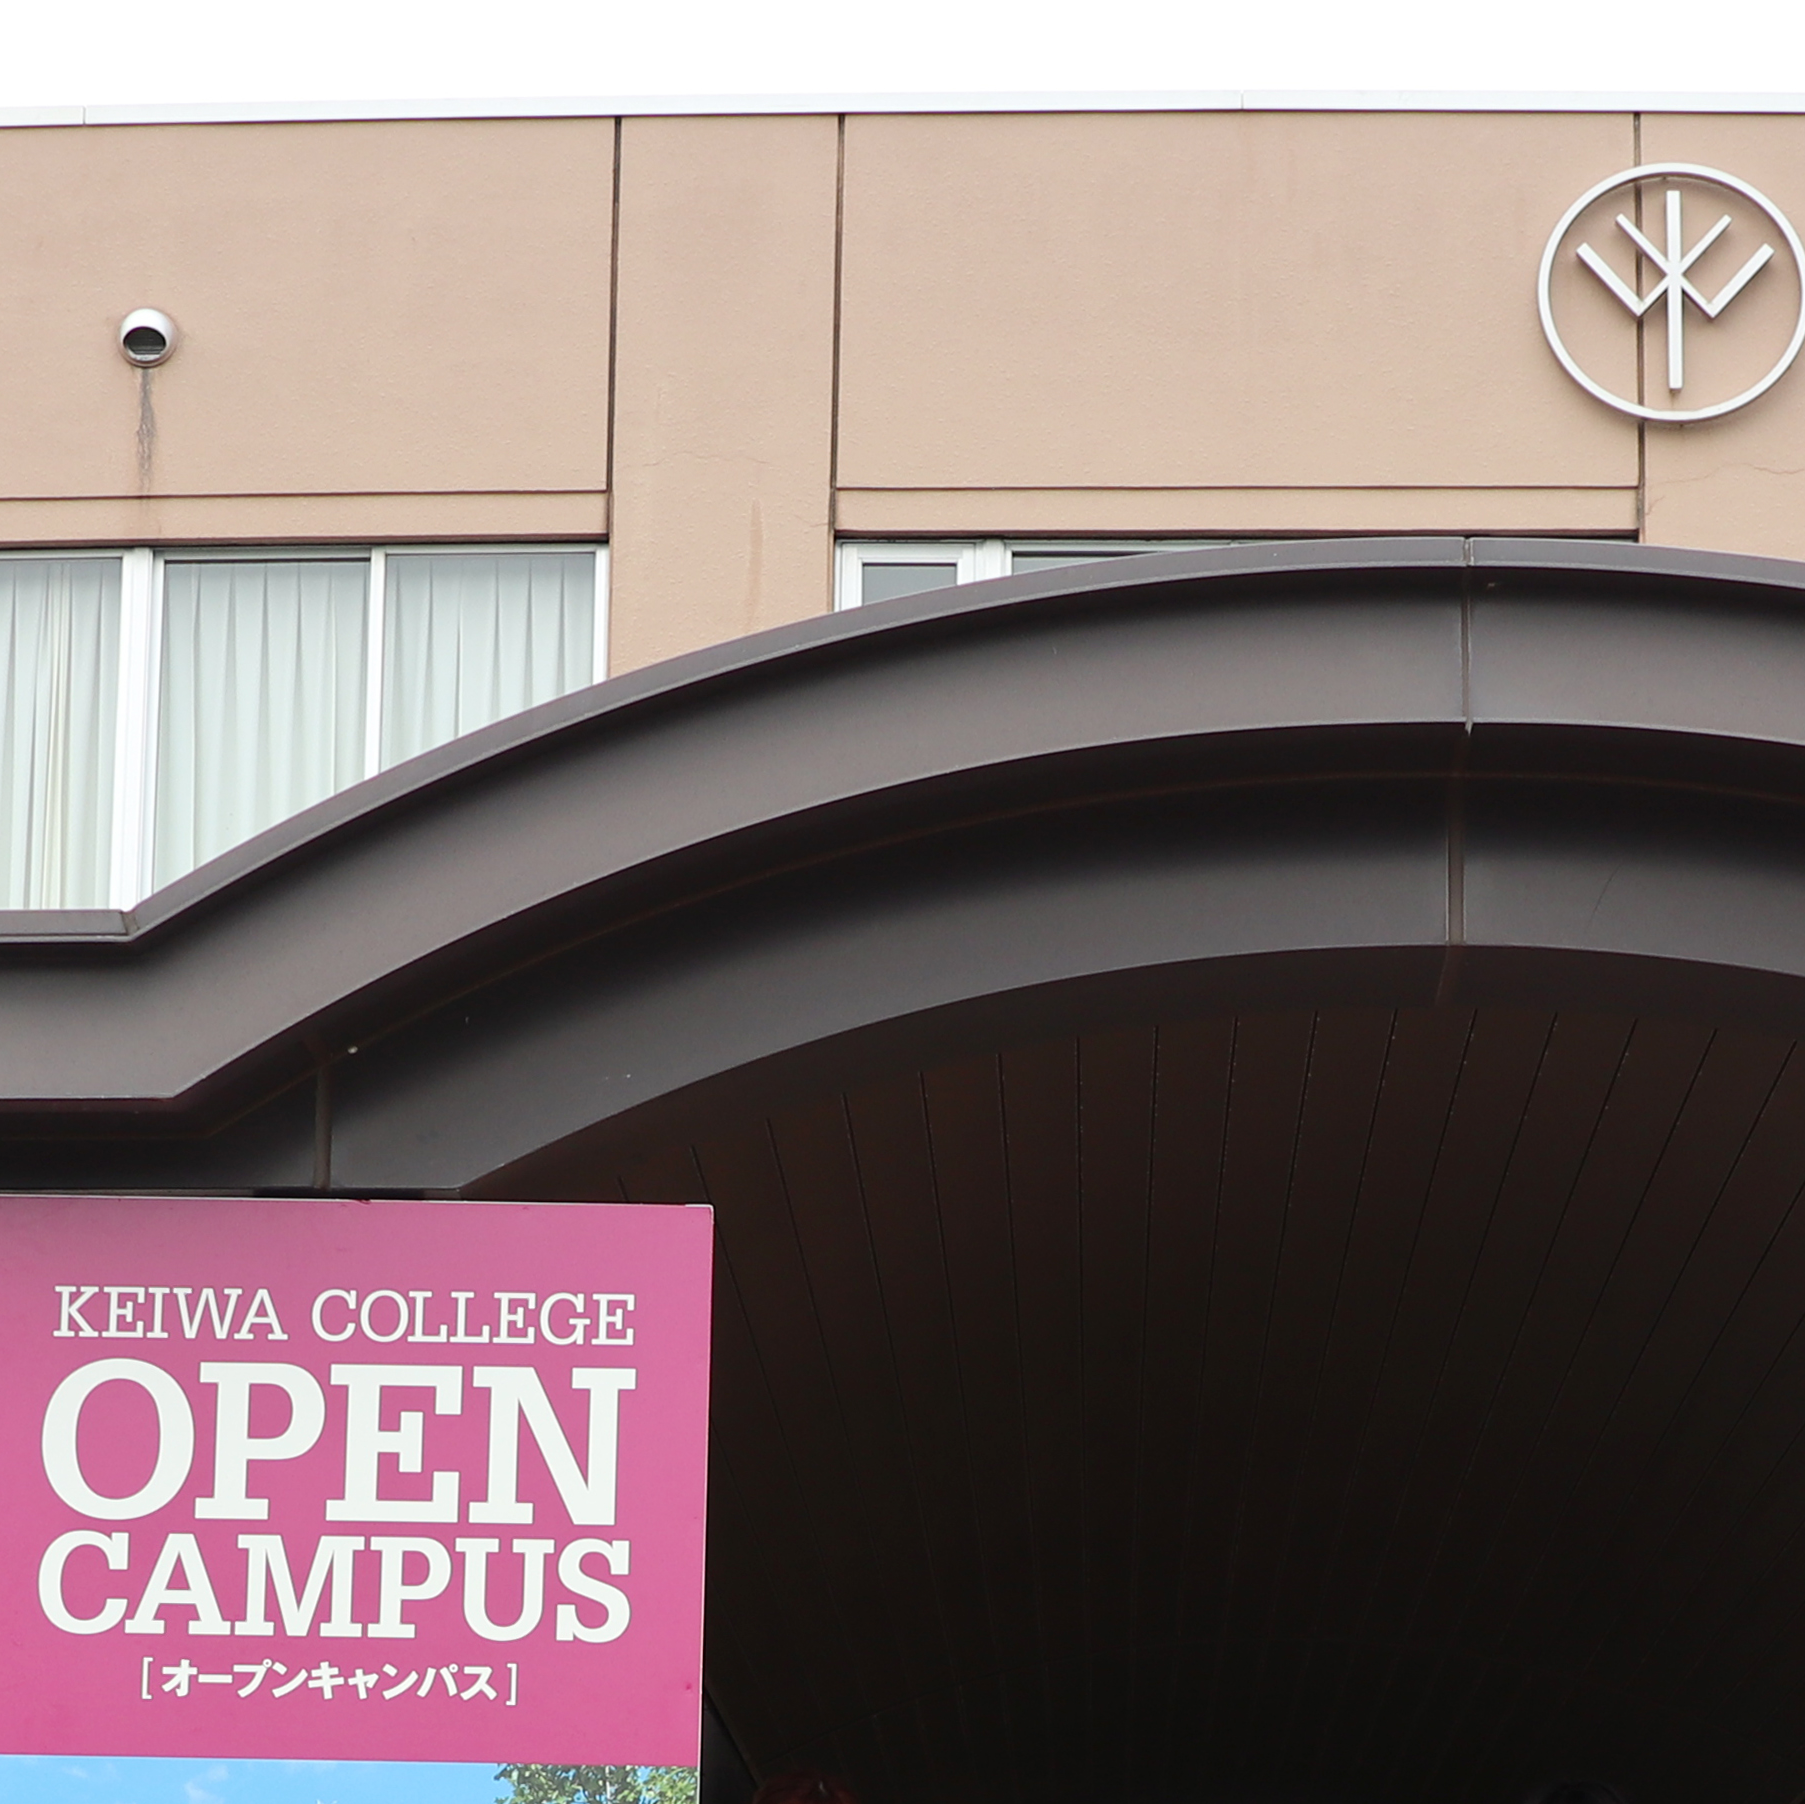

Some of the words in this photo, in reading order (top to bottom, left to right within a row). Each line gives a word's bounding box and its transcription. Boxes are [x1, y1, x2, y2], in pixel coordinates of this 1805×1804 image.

[53, 1285, 289, 1341] KEIWA
[311, 1289, 636, 1346] COLLEGE
[41, 1358, 637, 1526] OPEN
[38, 1530, 632, 1643] CAMPUS
